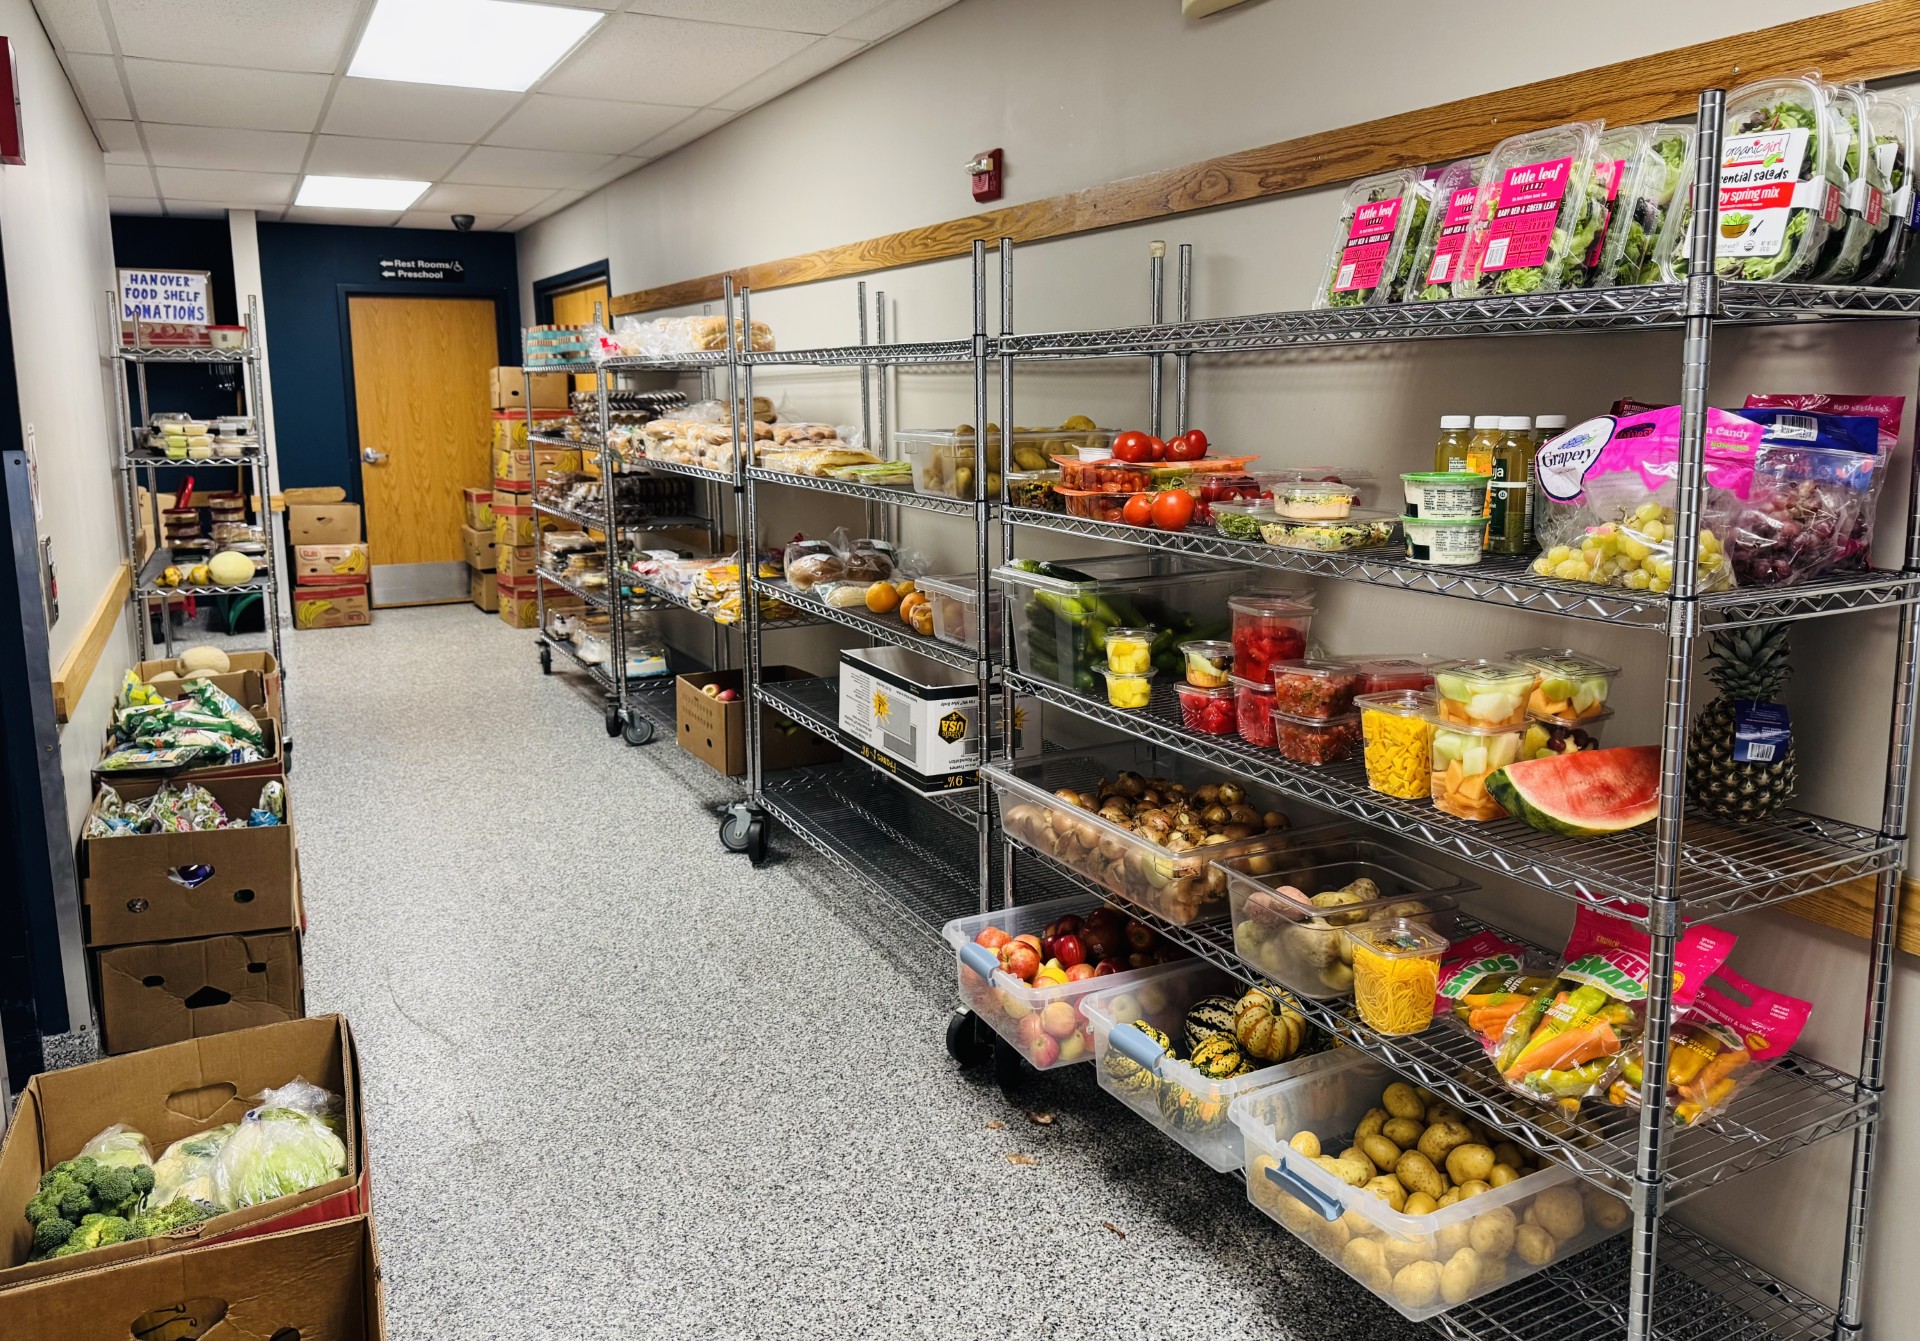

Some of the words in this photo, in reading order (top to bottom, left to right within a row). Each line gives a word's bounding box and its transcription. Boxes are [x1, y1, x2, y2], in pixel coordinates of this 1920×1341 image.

[1510, 169, 1536, 186] little
[1538, 163, 1563, 181] leaf
[1721, 169, 1752, 184] ential
[1754, 168, 1789, 180] salads
[1730, 188, 1760, 203] spring
[1761, 186, 1780, 199] mix
[1359, 206, 1377, 220] little
[1378, 202, 1396, 218] leaf
[1497, 208, 1509, 218] BABY
[1510, 207, 1520, 216] RED
[1526, 203, 1542, 213] GREEN
[1543, 201, 1556, 210] LEAF
[394, 259, 415, 267] Rest
[130, 274, 190, 287] HANOVER
[398, 270, 443, 278] Preschool
[125, 288, 157, 300] FOOD
[163, 290, 200, 302] SHELF
[124, 304, 204, 321] DONATIONS
[1715, 427, 1750, 440] Candy
[1542, 448, 1595, 468] Grapery
[942, 720, 964, 732] USA
[877, 753, 897, 774] Frames
[1688, 1039, 1717, 1056] SWEET
